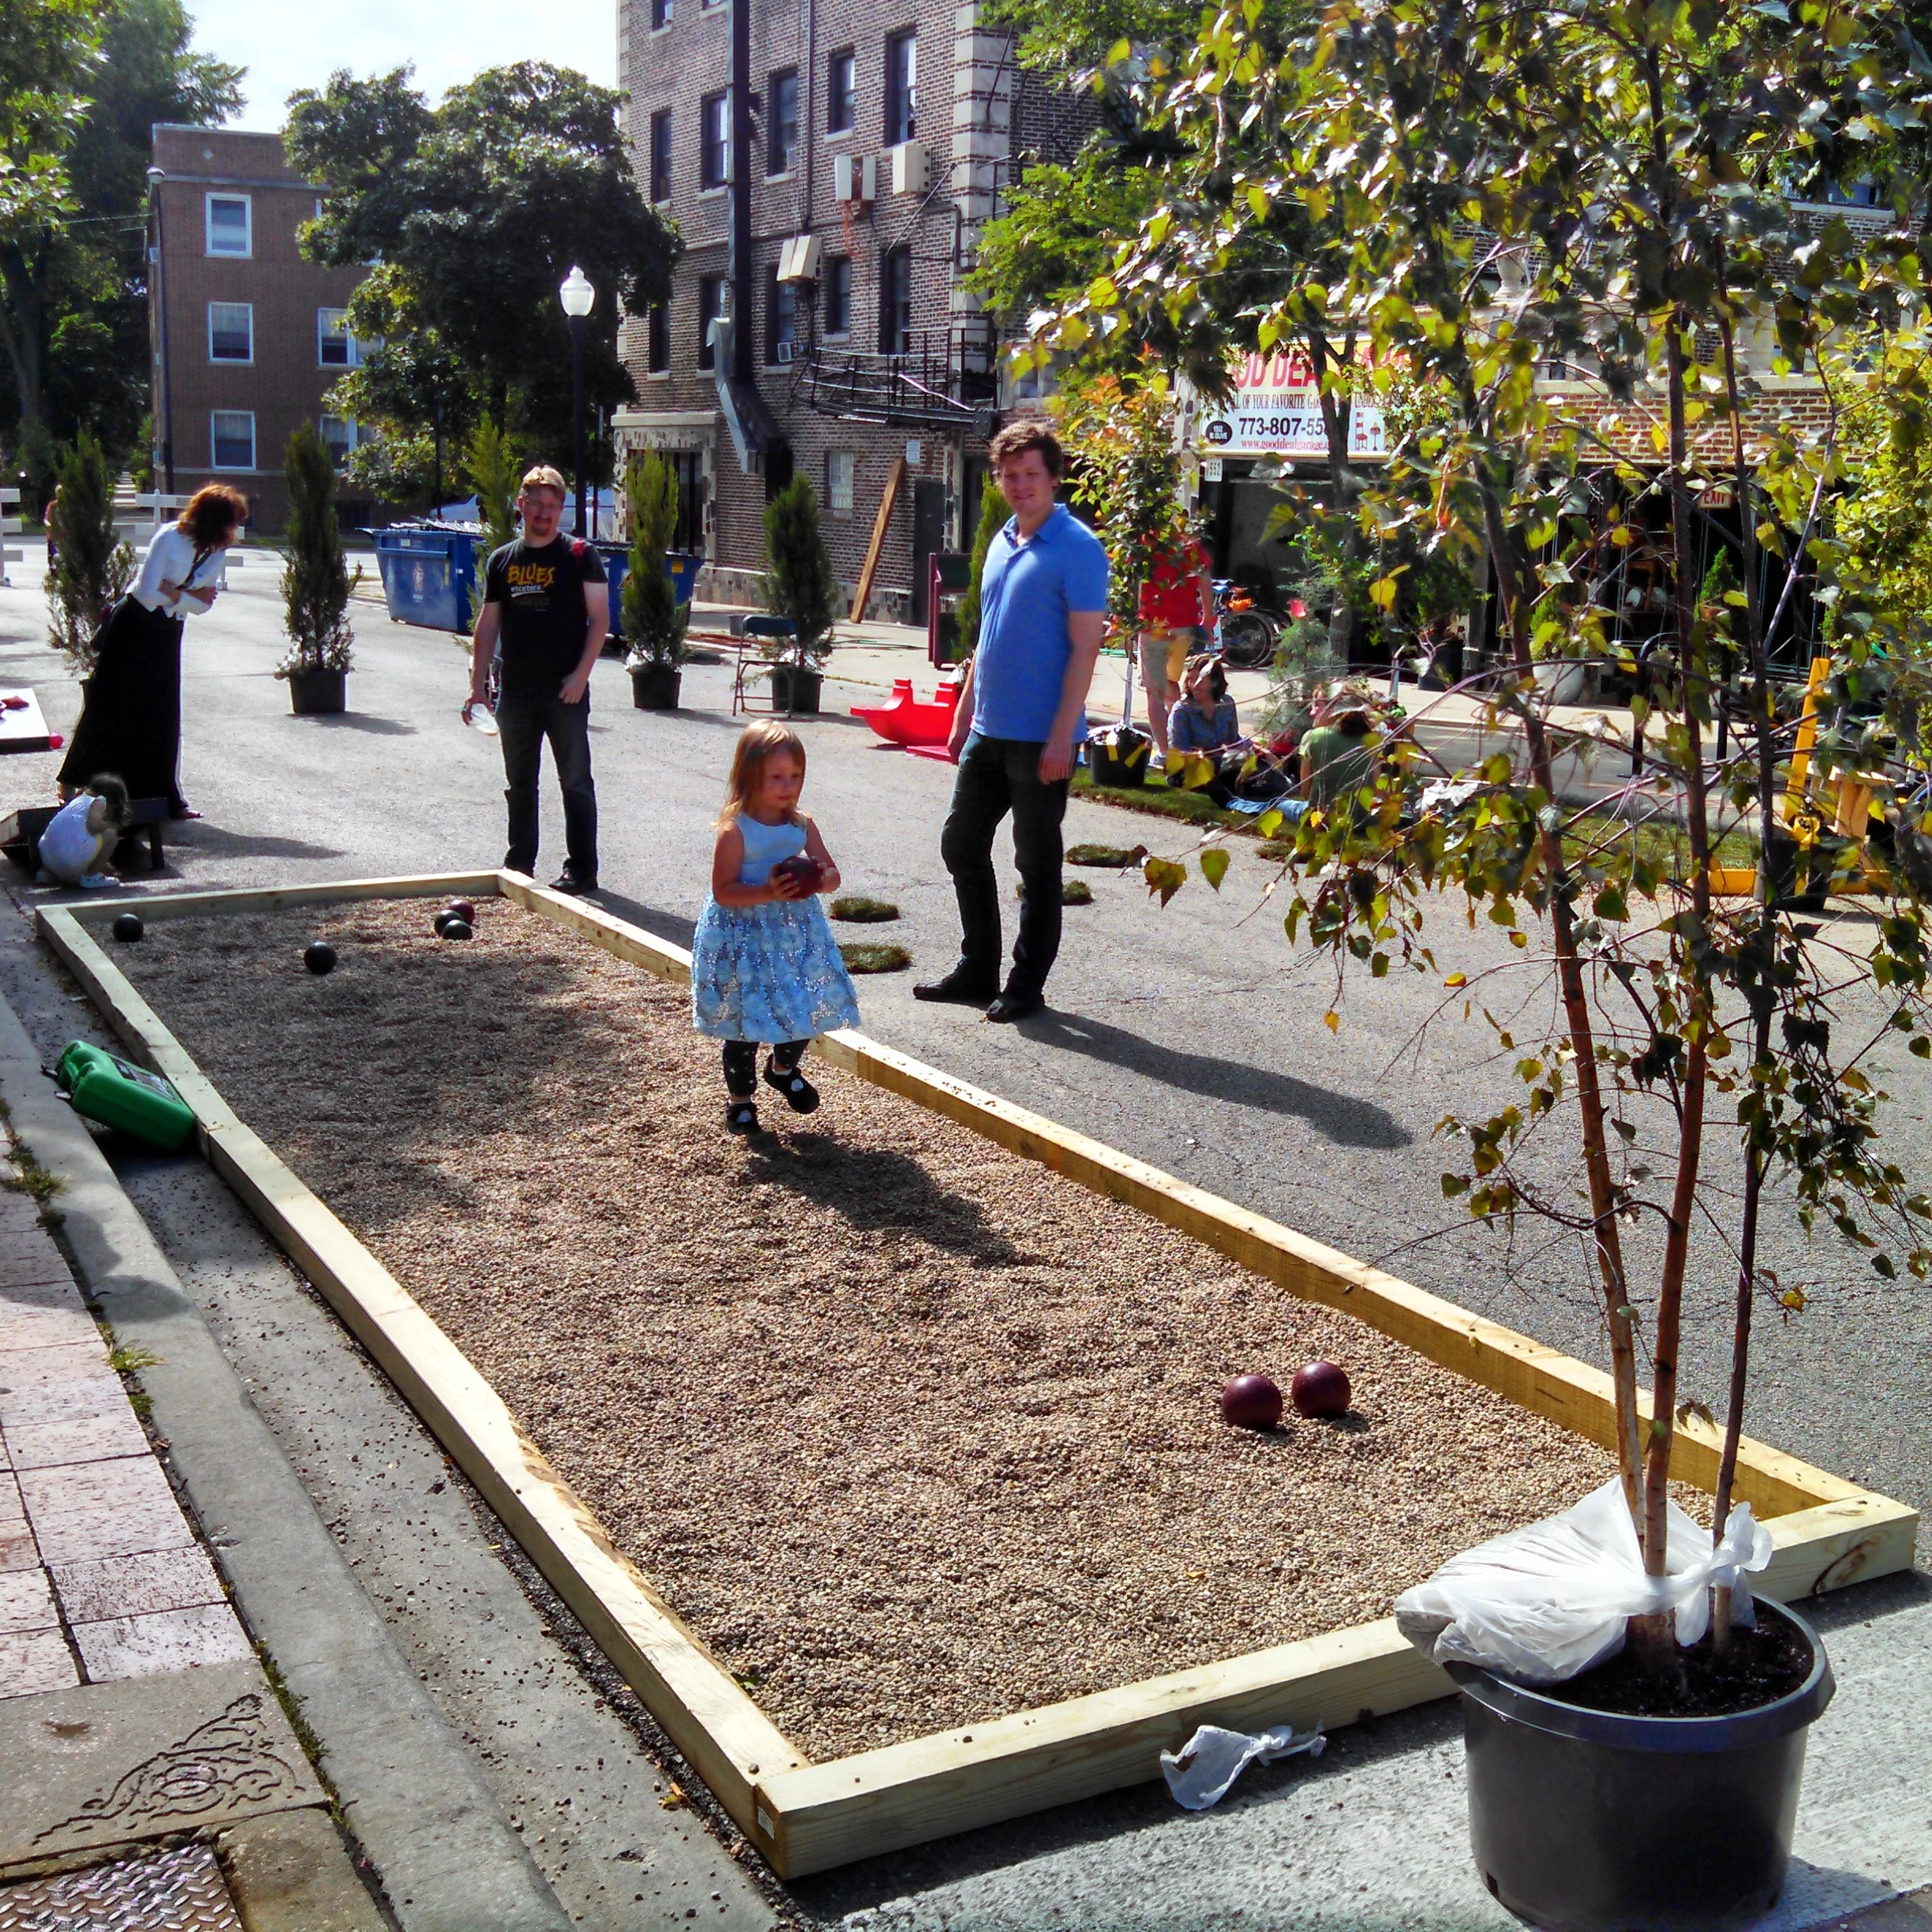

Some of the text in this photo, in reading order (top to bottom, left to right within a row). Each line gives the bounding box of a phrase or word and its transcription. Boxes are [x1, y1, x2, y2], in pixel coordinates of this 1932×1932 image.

[1234, 351, 1266, 387] OD
[1242, 394, 1251, 409] OF
[1252, 394, 1270, 409] YOUR
[1271, 393, 1305, 409] FAVORITE
[1239, 417, 1326, 435] 773-807-55
[1241, 438, 1329, 450] www.gooddealgarage.c
[1705, 491, 1724, 504] EXIT
[507, 563, 556, 587] BLUES
